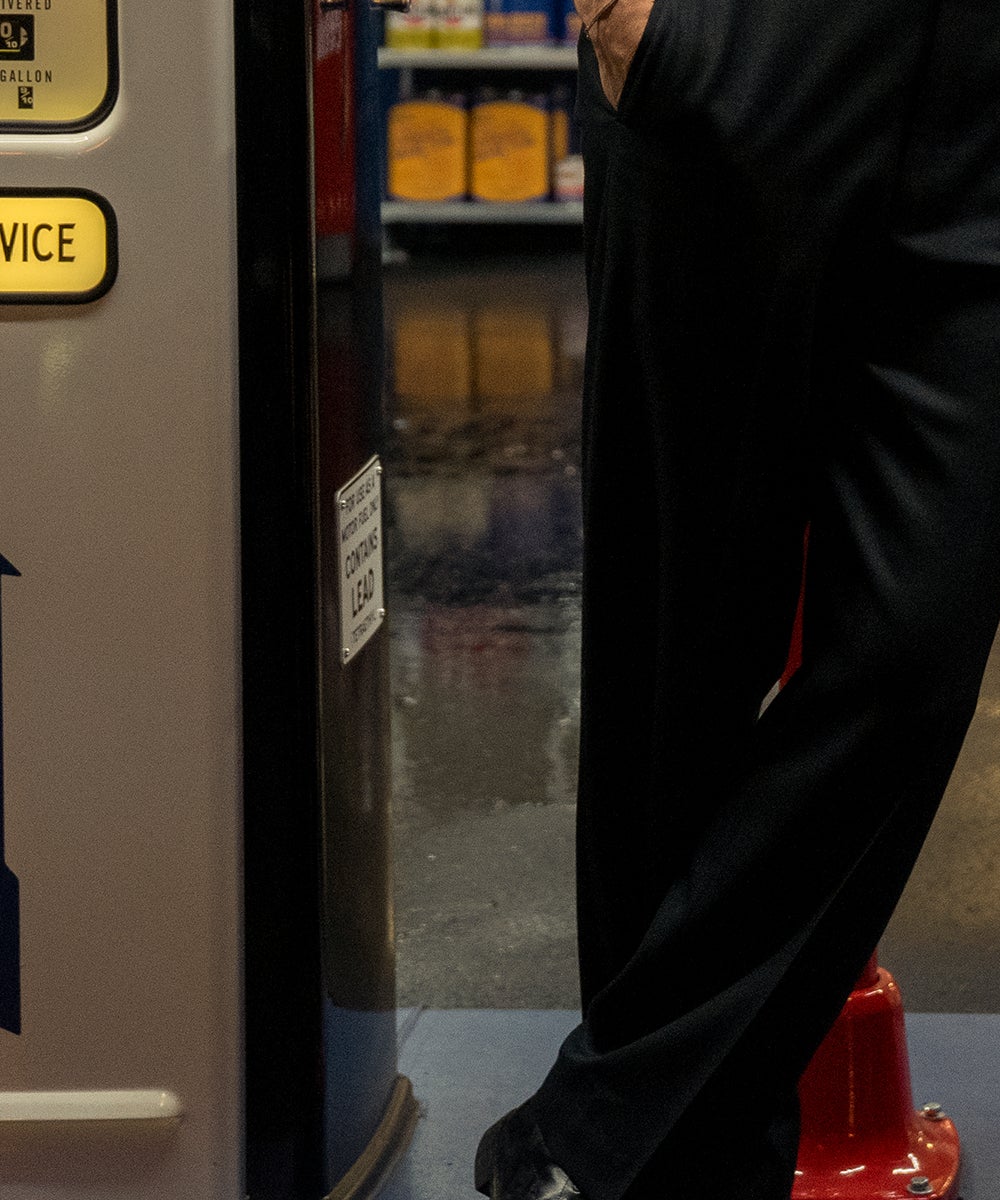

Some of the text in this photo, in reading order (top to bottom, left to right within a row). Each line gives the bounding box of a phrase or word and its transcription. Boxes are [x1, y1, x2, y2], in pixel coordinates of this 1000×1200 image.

[0, 69, 53, 83] GALLON
[0, 222, 77, 263] VICE
[345, 526, 378, 580] CONTAINS
[351, 568, 375, 618] LEAD
